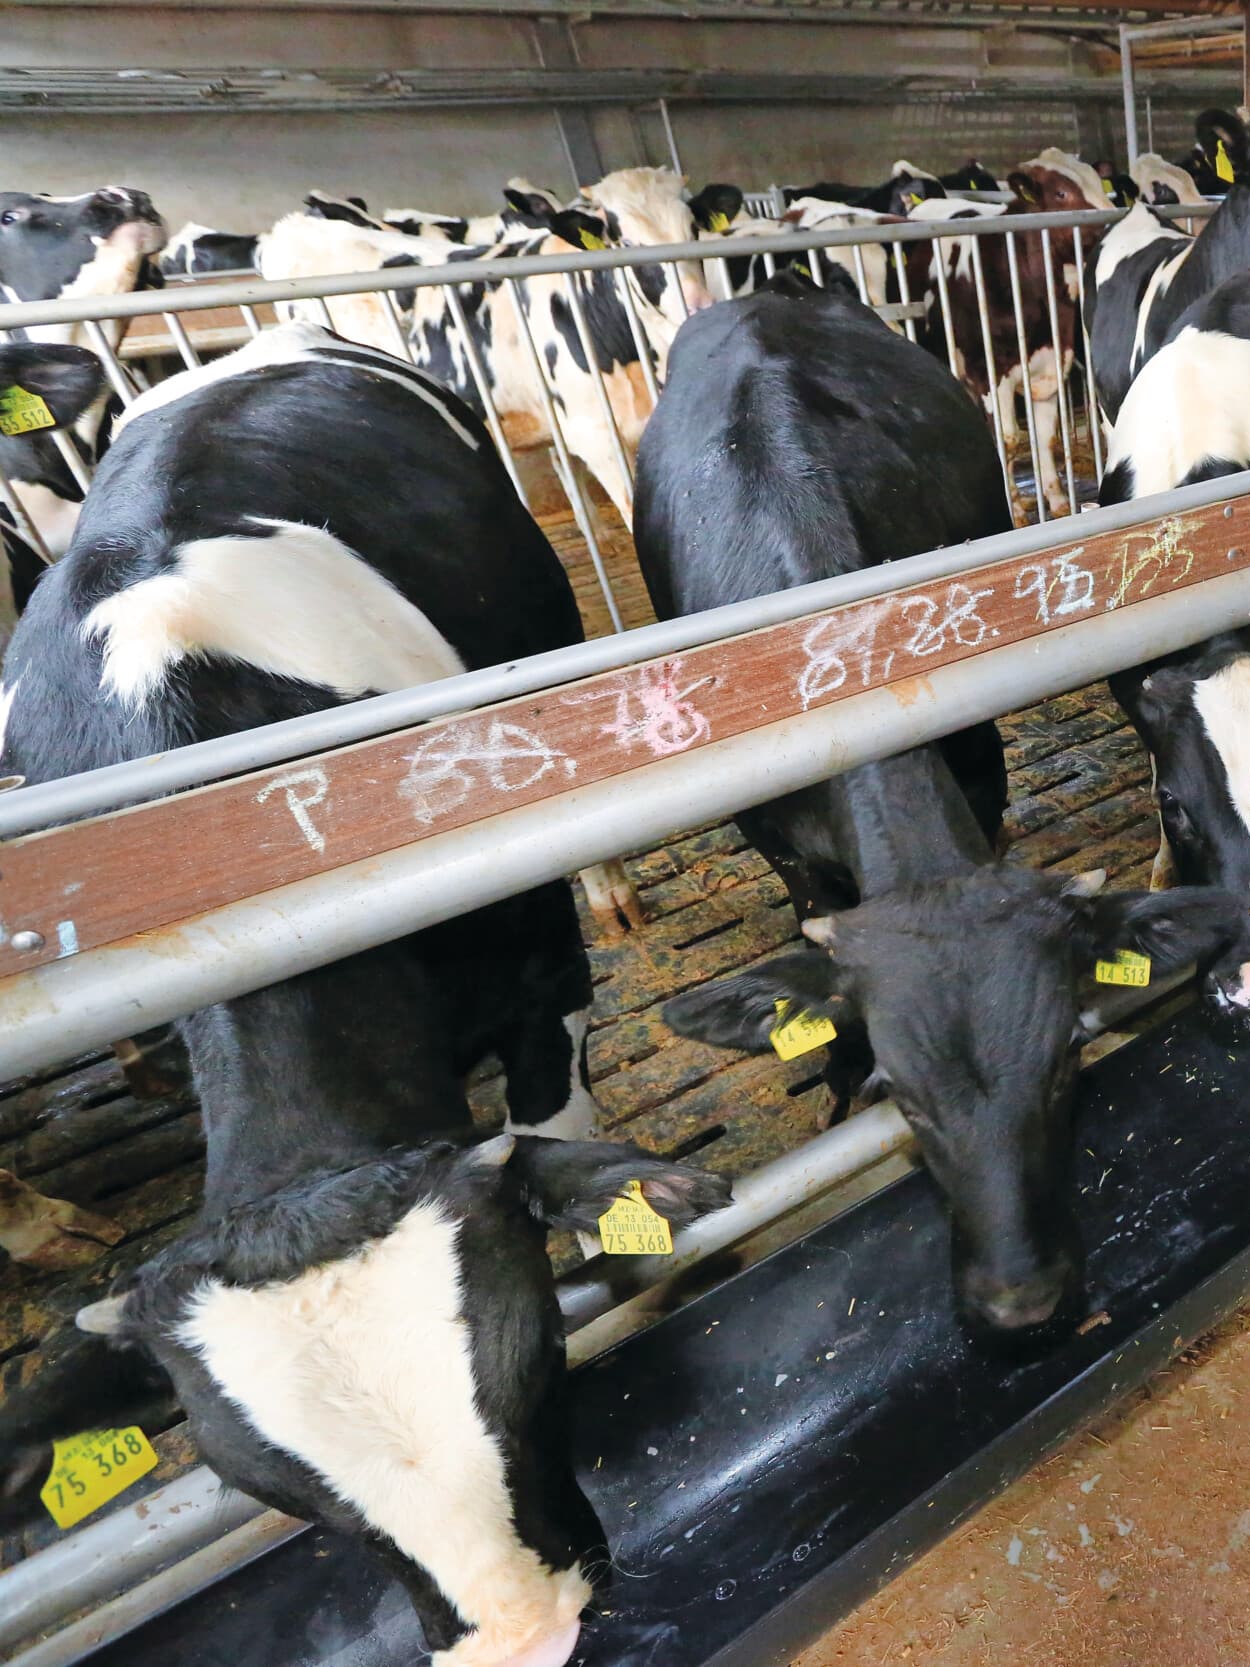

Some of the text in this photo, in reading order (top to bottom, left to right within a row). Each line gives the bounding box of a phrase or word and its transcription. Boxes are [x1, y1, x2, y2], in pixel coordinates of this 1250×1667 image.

[21, 408, 52, 428] 512
[256, 768, 329, 855] P
[1123, 966, 1145, 984] 513
[605, 1233, 667, 1252] 75 368
[49, 1433, 142, 1509] 75 368
